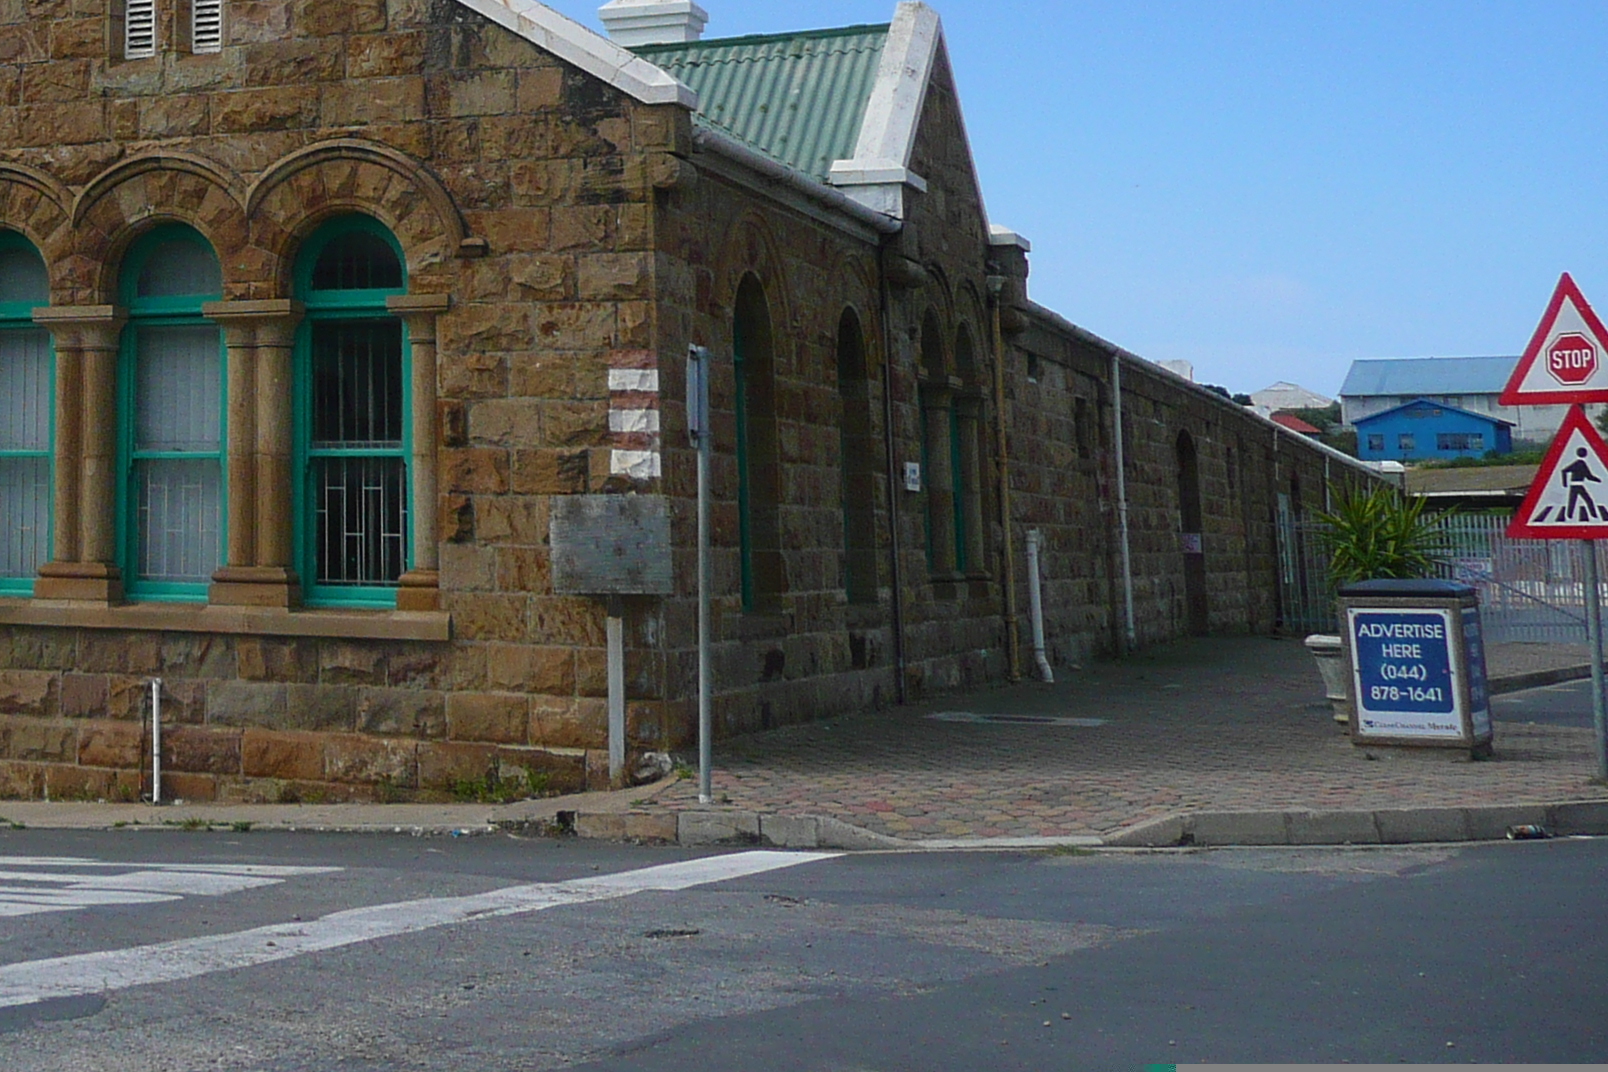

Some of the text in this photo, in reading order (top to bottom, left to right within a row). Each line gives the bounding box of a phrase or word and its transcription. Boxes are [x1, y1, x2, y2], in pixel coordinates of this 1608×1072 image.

[1552, 349, 1591, 369] STOP
[1358, 623, 1443, 638] ADVERTISE
[1381, 643, 1422, 659] HERE
[1380, 663, 1427, 681] (044)
[1370, 686, 1443, 702] 878-1641
